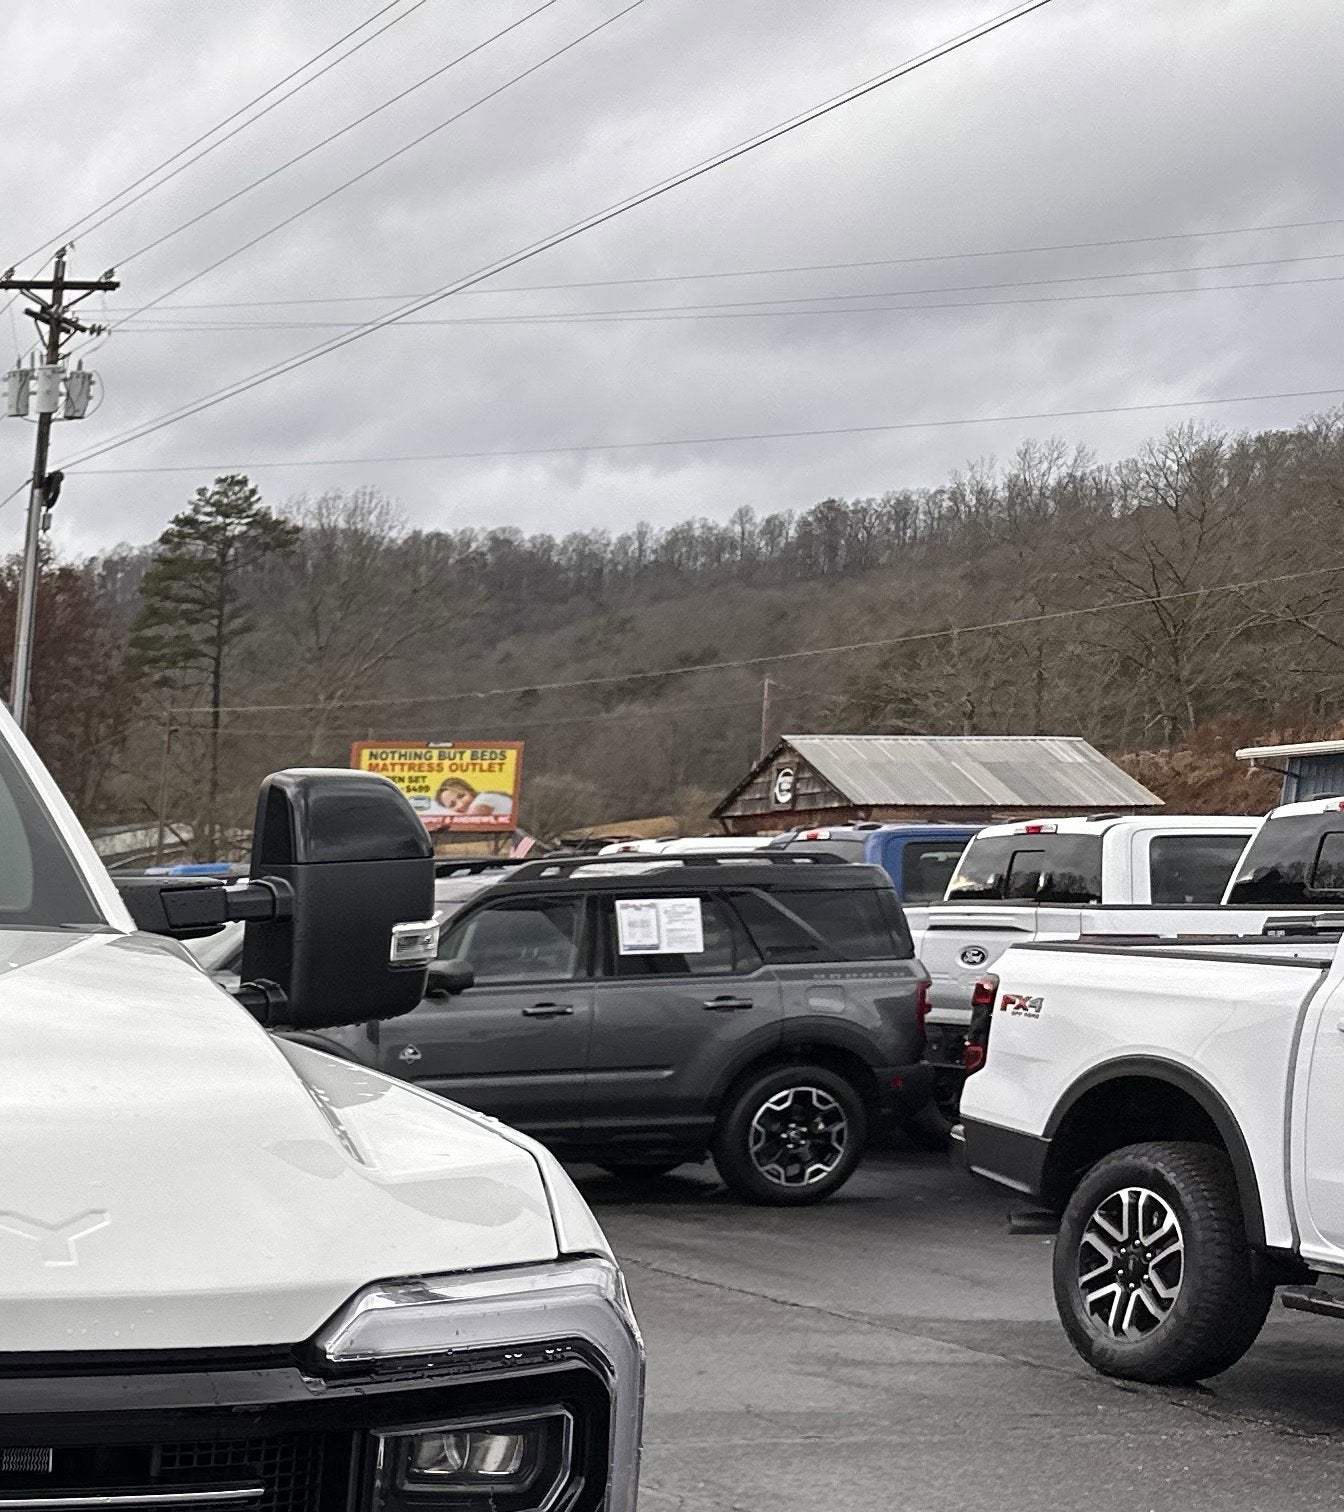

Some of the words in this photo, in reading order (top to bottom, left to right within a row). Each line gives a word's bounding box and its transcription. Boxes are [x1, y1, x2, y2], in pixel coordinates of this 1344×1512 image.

[368, 750, 433, 761] NOTHING
[437, 750, 466, 761] BUT
[470, 750, 507, 761] BEDS
[367, 762, 445, 773] MATTRESS
[448, 762, 505, 773] OUTLET
[408, 775, 428, 784] SET
[1000, 994, 1044, 1013] FX4
